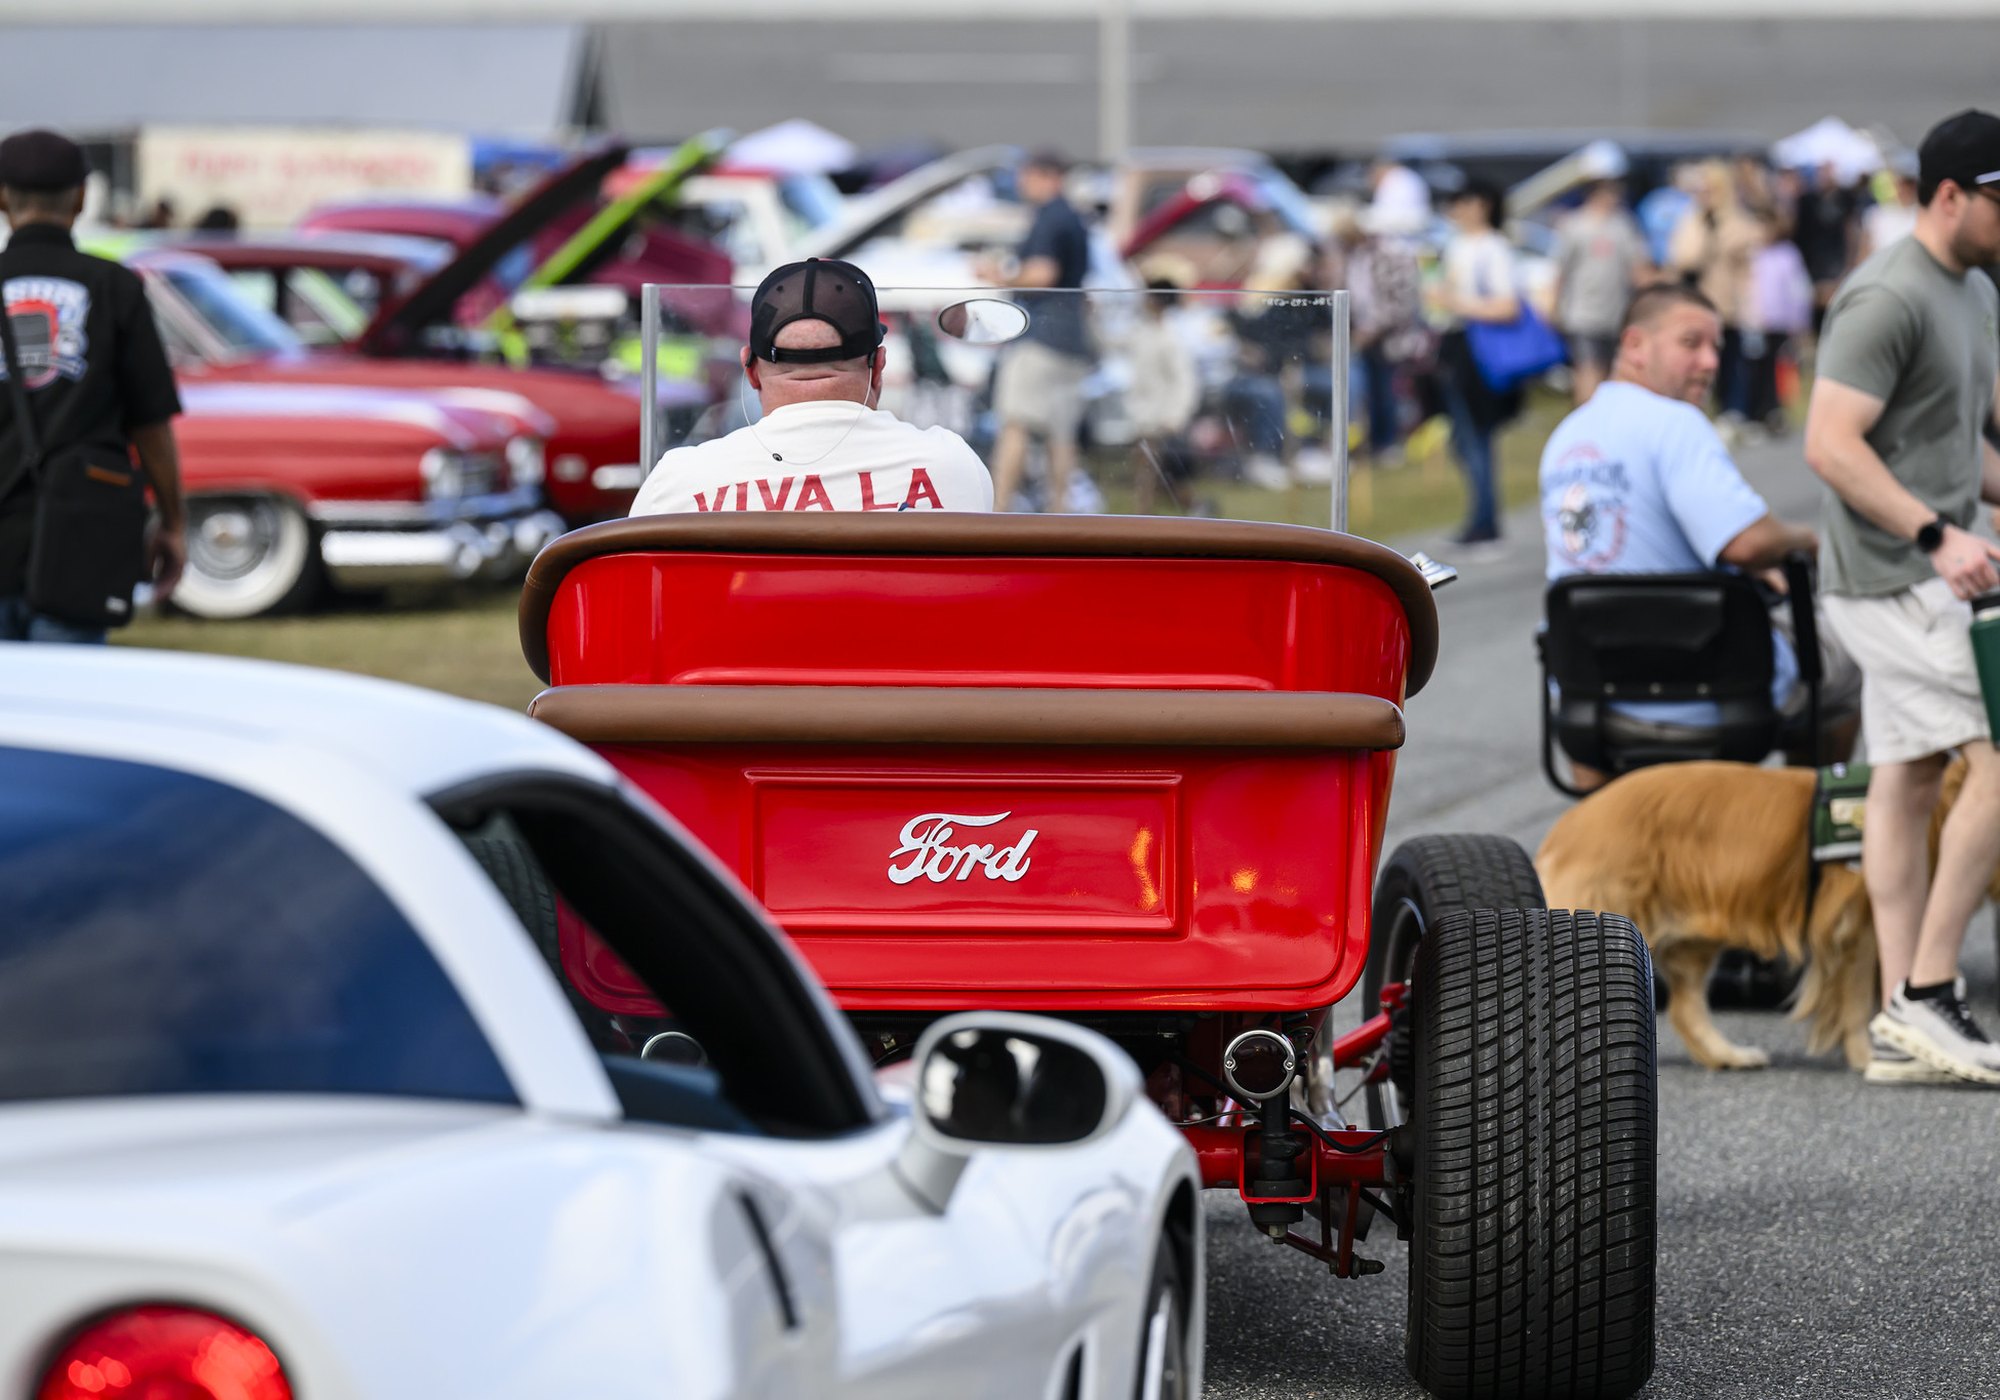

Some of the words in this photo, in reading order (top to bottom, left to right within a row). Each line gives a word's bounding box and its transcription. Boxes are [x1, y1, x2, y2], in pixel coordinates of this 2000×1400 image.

[693, 474, 835, 512] VIVA
[857, 467, 945, 511] LA
[887, 810, 1039, 885] Ford
